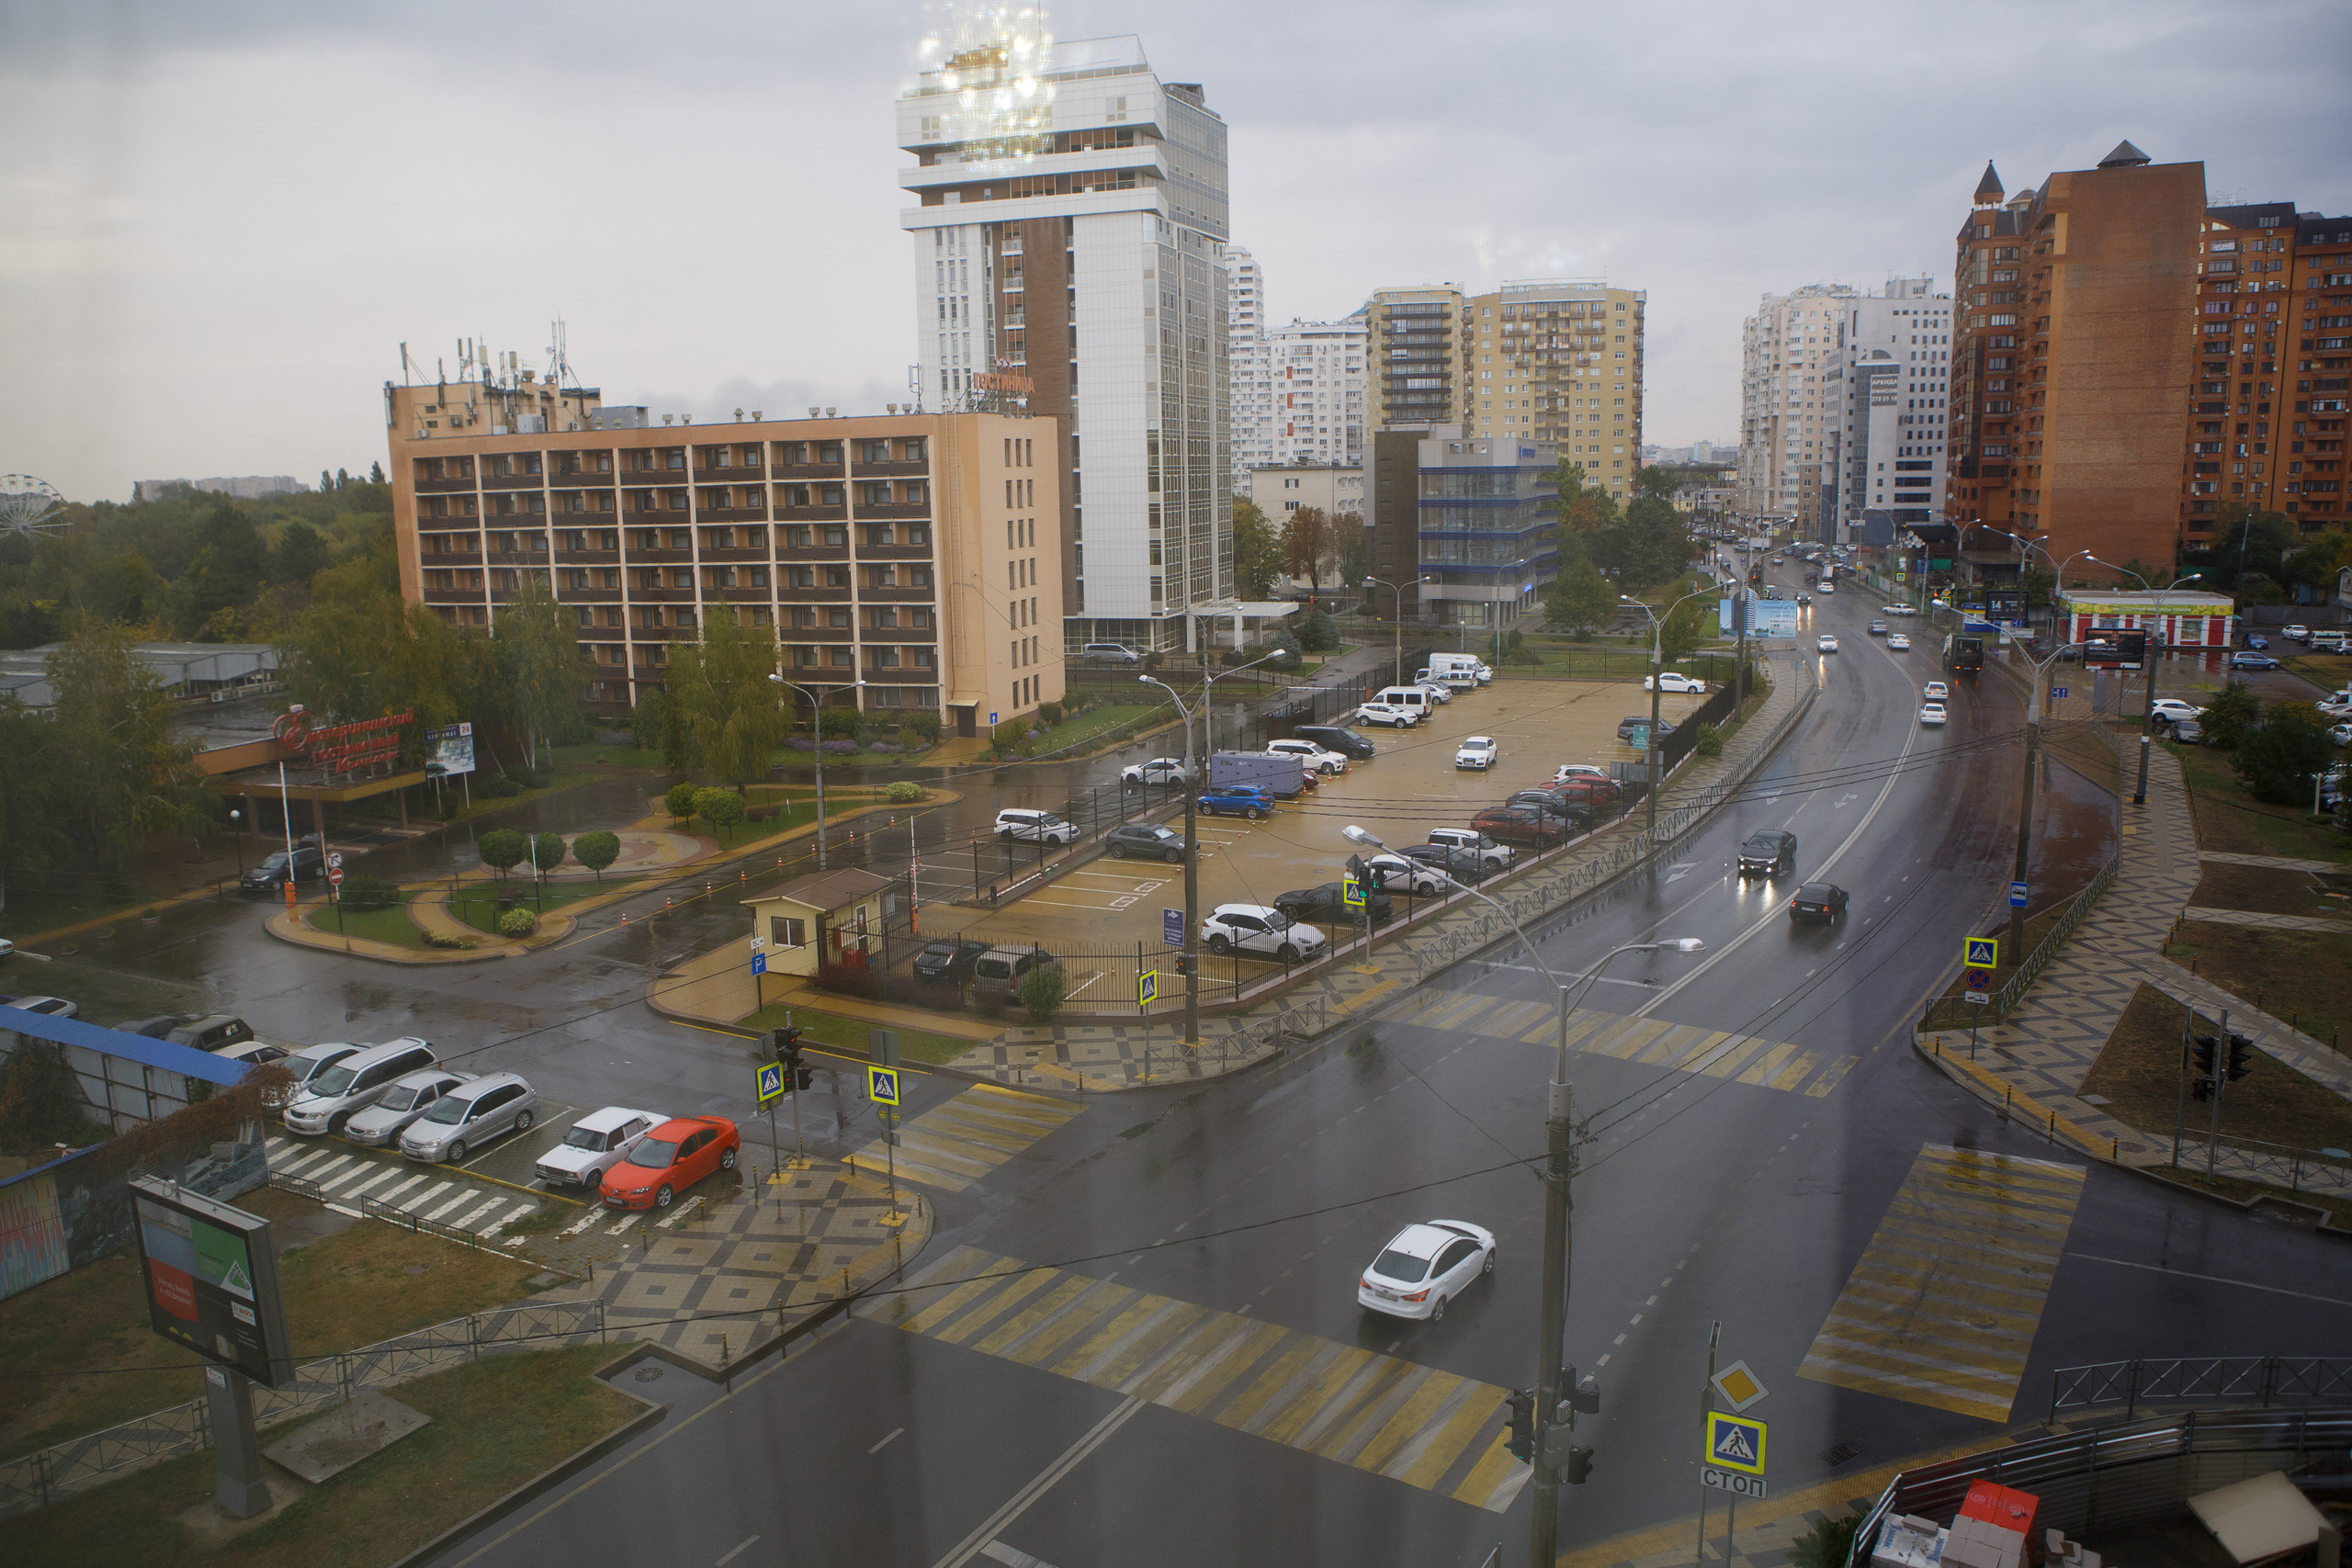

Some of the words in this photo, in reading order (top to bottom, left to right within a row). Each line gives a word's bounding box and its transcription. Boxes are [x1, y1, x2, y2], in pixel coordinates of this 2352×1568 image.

[973, 372, 1035, 396] ГОСТИНИЦА
[1990, 600, 2002, 610] 14
[427, 730, 457, 740] БАНОМАТ
[461, 725, 470, 734] 24
[239, 1307, 254, 1318] BOSCH
[1703, 1469, 1763, 1497] СТОП
